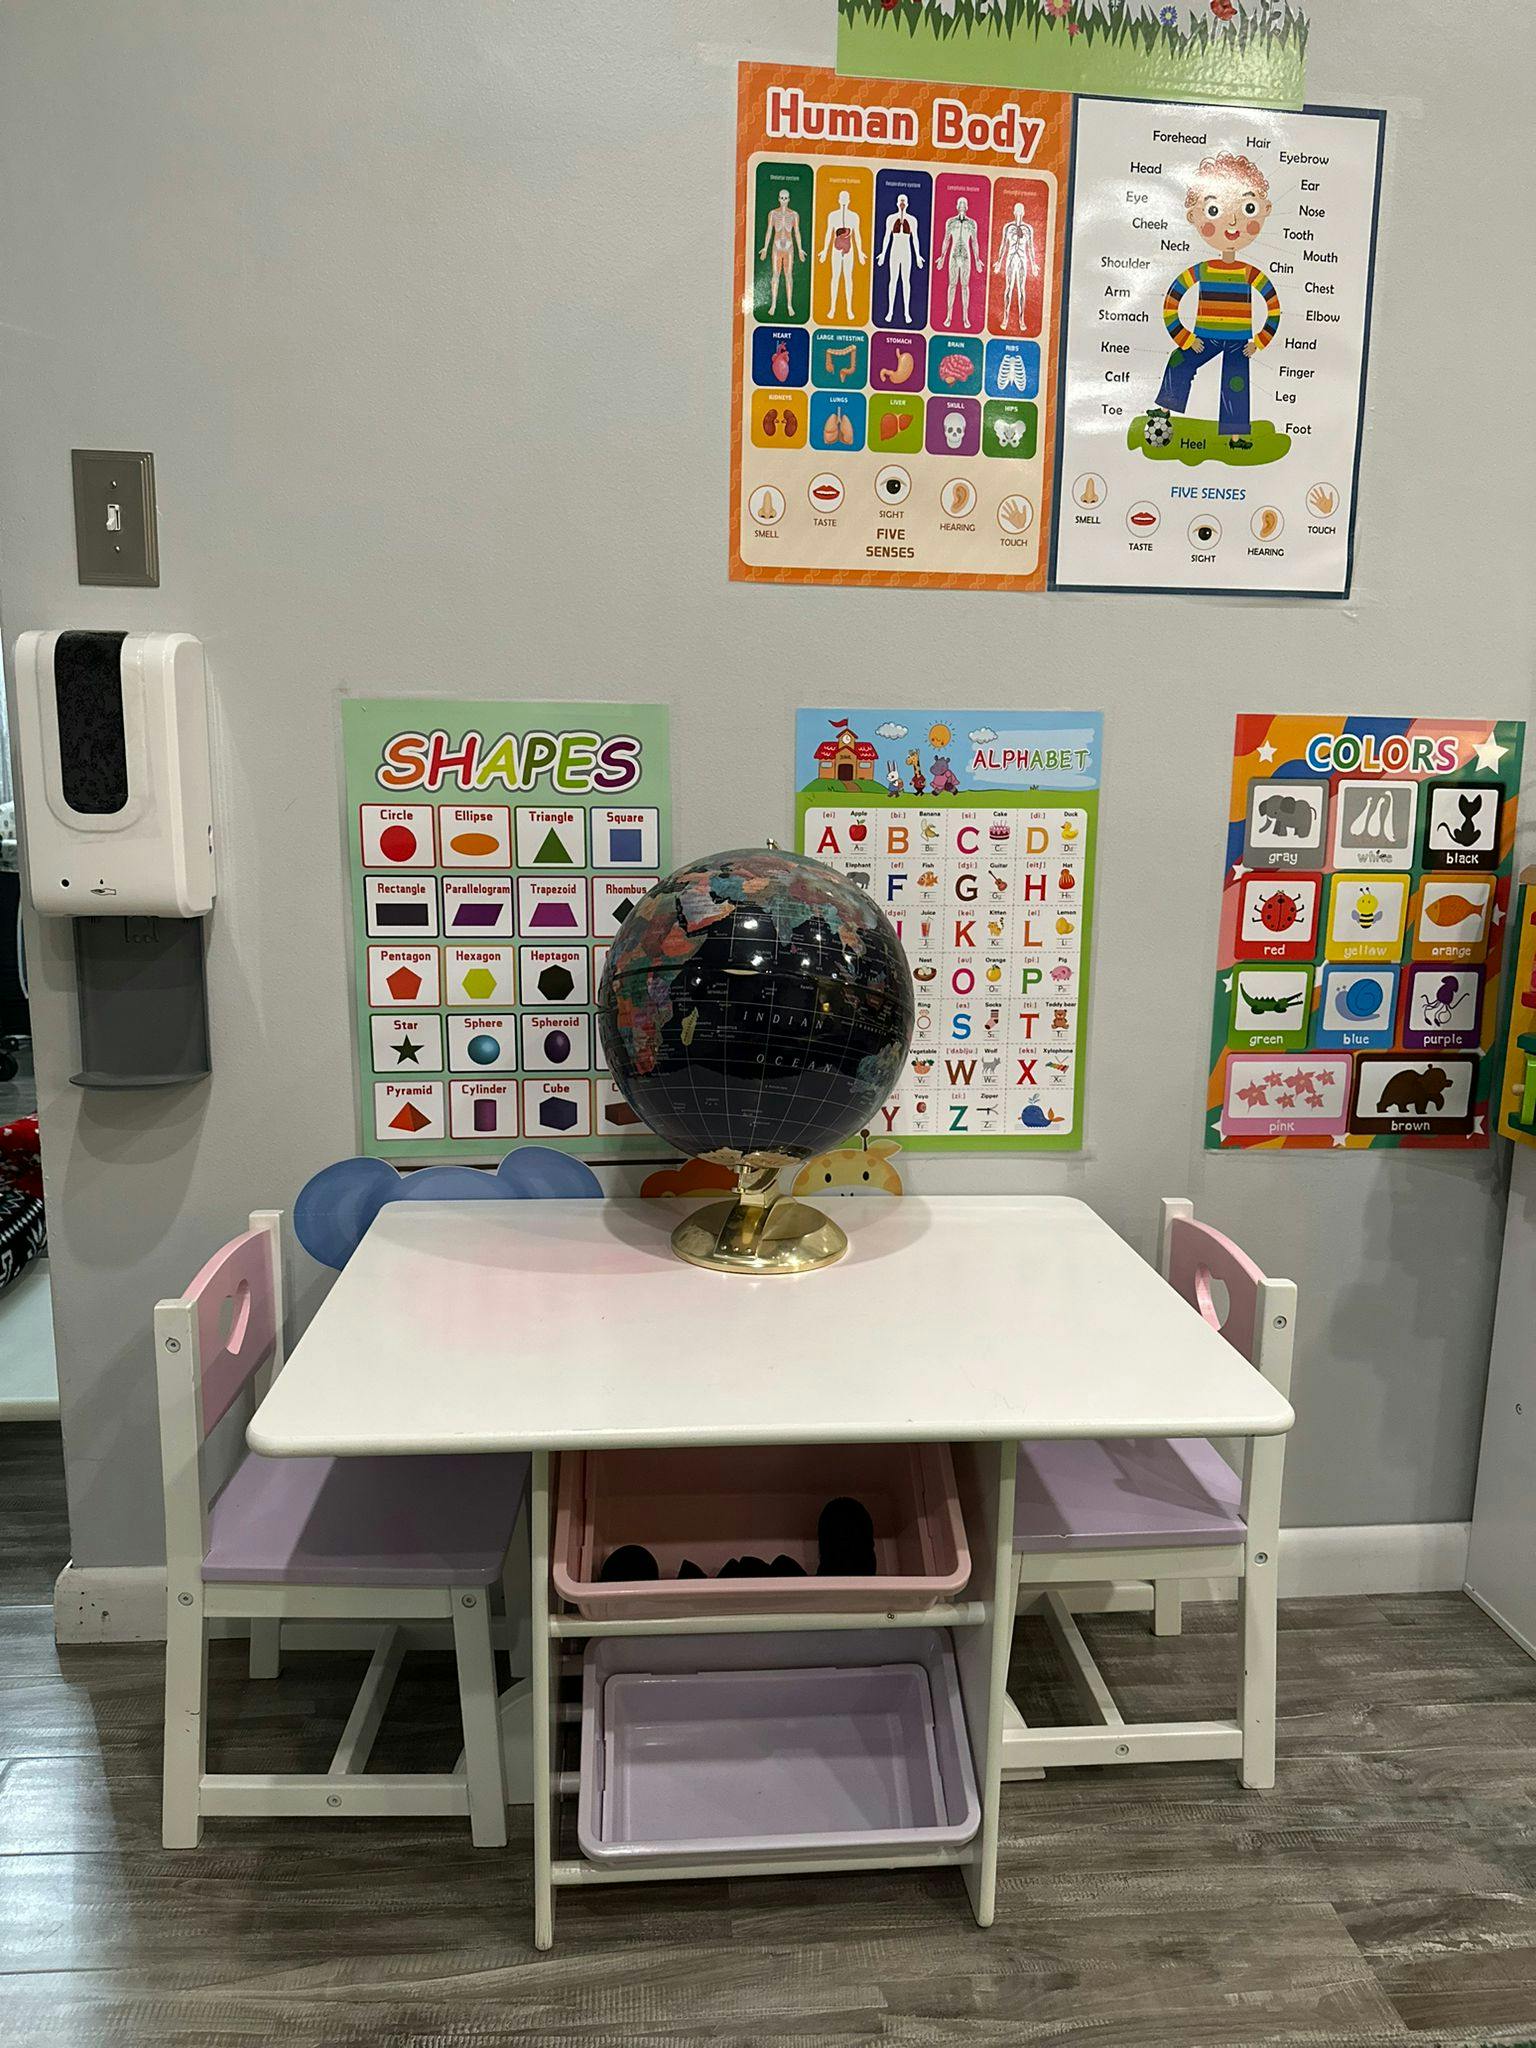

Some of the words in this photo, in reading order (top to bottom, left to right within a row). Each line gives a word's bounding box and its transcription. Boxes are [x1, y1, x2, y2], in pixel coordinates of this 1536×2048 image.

[766, 87, 918, 145] Human
[932, 97, 1046, 163] Body
[1152, 130, 1208, 145] Forehead
[1246, 136, 1272, 149] Hair
[1279, 151, 1330, 168] Eyebrow
[1130, 162, 1162, 174] Head
[1301, 180, 1320, 192] Ear
[1126, 190, 1148, 205] Eye
[1299, 206, 1326, 218] Nose
[1132, 218, 1168, 231] Cheek
[1283, 228, 1314, 242] Tooth
[1160, 240, 1190, 252] Neck
[1100, 256, 1151, 270] Shoulder
[1303, 250, 1338, 264] Mouth
[1270, 262, 1294, 274] Chin
[1104, 286, 1131, 298] Arm
[1304, 282, 1335, 295] Chest
[1098, 309, 1150, 324] Stomach
[1306, 310, 1341, 324] Elbow
[836, 334, 864, 342] INTESTINE
[886, 337, 912, 345] STOMACH
[1285, 338, 1318, 350] Hand
[1101, 342, 1130, 354] Knee
[1105, 372, 1130, 383] Calf
[1279, 366, 1315, 380] Finger
[1275, 390, 1297, 404] Leg
[1101, 404, 1123, 416] Toe
[1286, 424, 1312, 435] Foot
[1180, 438, 1206, 450] Heel
[1171, 486, 1198, 499] FIVE
[1201, 488, 1247, 501] SENSES
[879, 510, 904, 519] SIGHT
[1075, 515, 1101, 525] SMELL
[813, 518, 837, 528] TASTE
[940, 522, 976, 532] HEARING
[754, 530, 780, 539] SMELL
[876, 528, 906, 541] FIVE
[1307, 526, 1336, 535] TOUCH
[1000, 538, 1028, 547] TOUCH
[1128, 542, 1154, 552] TASTE
[866, 546, 915, 559] SENSES
[1191, 554, 1216, 564] SIGHT
[1247, 547, 1284, 558] HEARING
[973, 748, 1092, 772] ALPHABET
[1306, 733, 1460, 774] COLORS
[376, 728, 642, 795] SHAPES
[380, 810, 414, 822] Circle
[454, 810, 494, 824] Ellipse
[528, 811, 574, 825] Triangle
[606, 812, 644, 825] Square
[816, 826, 841, 854] A
[887, 826, 909, 854] B
[957, 826, 980, 854] C
[1026, 826, 1049, 854] D
[1268, 850, 1298, 866] gray
[1357, 849, 1394, 864] white
[1446, 851, 1479, 864] black
[377, 883, 426, 896] Rectangle
[445, 883, 510, 897] Parallelogram
[530, 884, 577, 896] Trapezoid
[606, 884, 648, 895] Rhombus
[888, 874, 908, 901] F
[955, 874, 978, 902] G
[1024, 874, 1047, 901] H
[954, 920, 976, 947] K
[1024, 920, 1042, 947] L
[456, 950, 502, 963] Hexagon
[530, 950, 580, 963] Heptagon
[1264, 944, 1286, 956] red
[1344, 944, 1387, 957] yellow
[1432, 946, 1472, 958] orange
[380, 950, 432, 964] Pentagon
[952, 968, 975, 995] O
[1021, 968, 1042, 994] P
[394, 1020, 418, 1030] Star
[464, 1018, 503, 1030] Sphere
[531, 1017, 580, 1028] Spheroid
[743, 1010, 824, 1030] INDIAN
[952, 1013, 972, 1040] S
[1019, 1013, 1040, 1039] T
[1249, 1033, 1284, 1046] green
[1343, 1033, 1370, 1045] blue
[1423, 1034, 1462, 1048] purple
[756, 1053, 834, 1073] OCEAN
[944, 1060, 978, 1085] W
[1016, 1060, 1038, 1085] X
[386, 1085, 433, 1098] Pyramid
[461, 1084, 507, 1096] Cylinder
[542, 1084, 570, 1094] Cube
[881, 1106, 900, 1132] Y
[949, 1106, 968, 1132] Z
[1269, 1120, 1294, 1132] pink
[1390, 1120, 1430, 1132] brown
